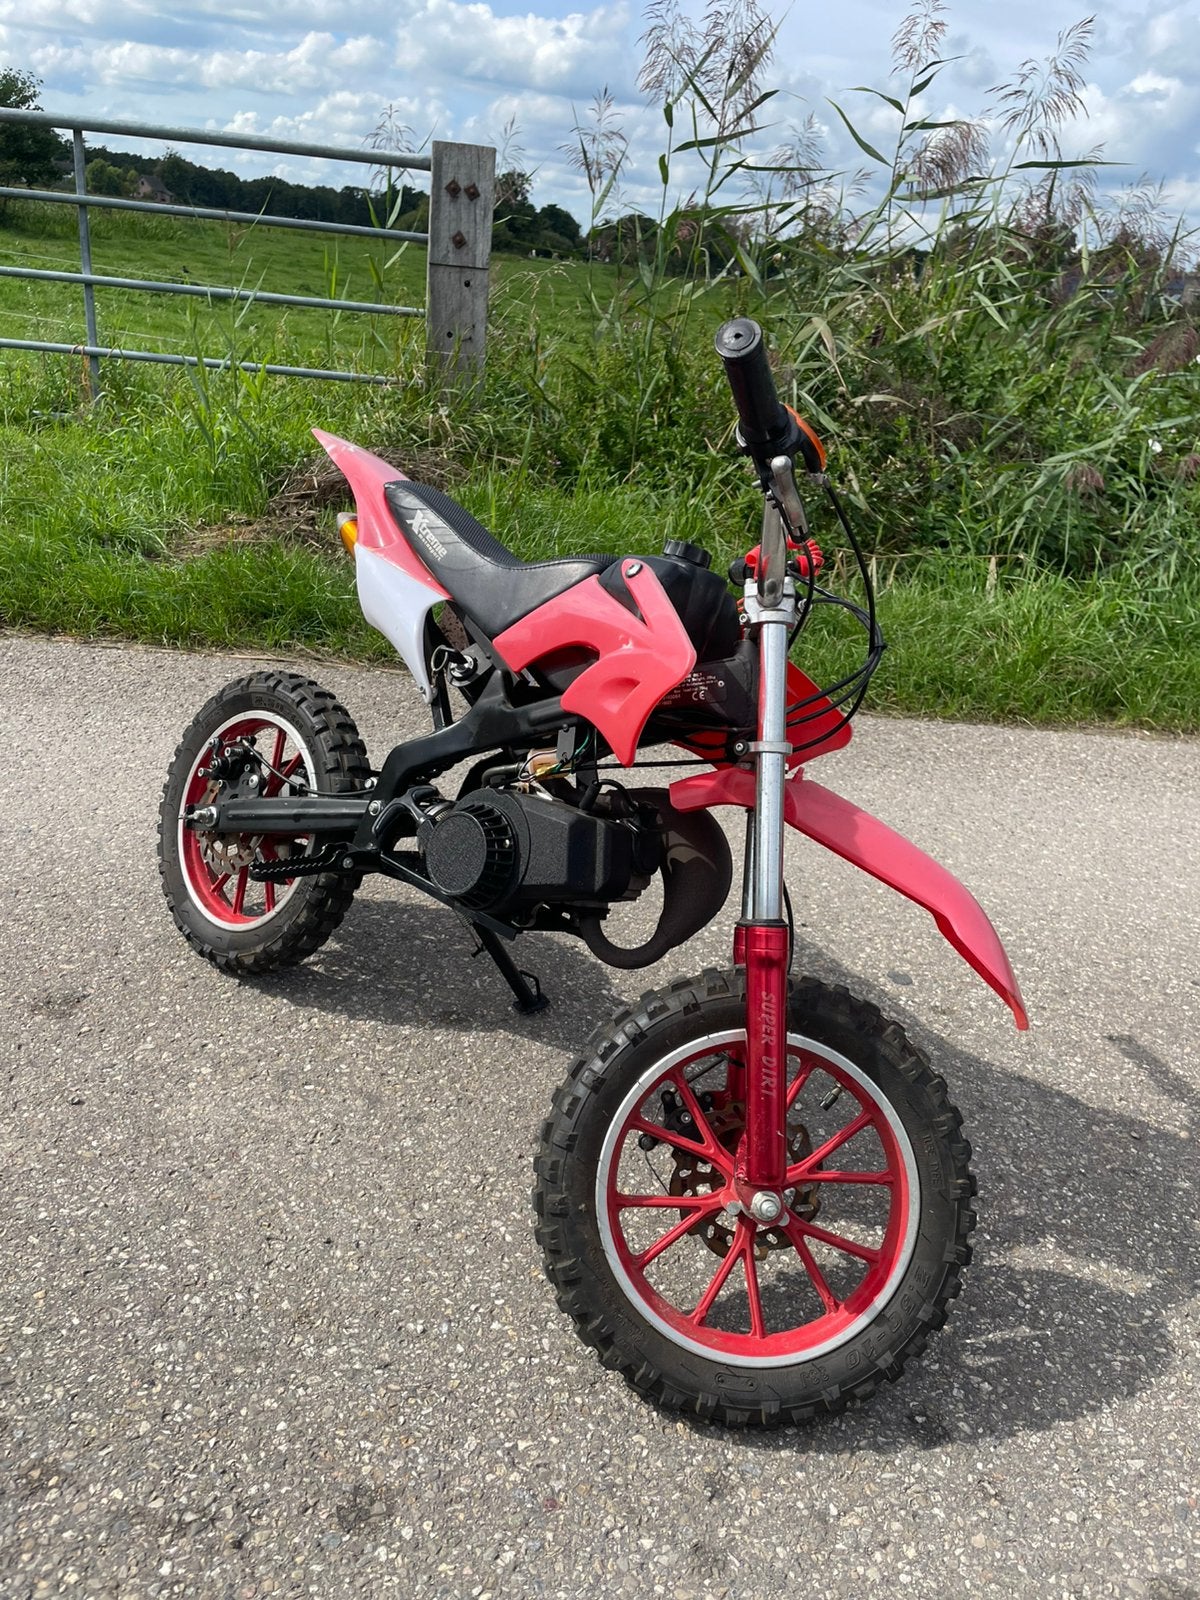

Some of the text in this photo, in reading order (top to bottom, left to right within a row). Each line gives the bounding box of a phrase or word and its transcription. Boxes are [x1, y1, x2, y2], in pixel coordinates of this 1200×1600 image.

[405, 509, 448, 558] Xtreme
[692, 691, 705, 701] CE
[761, 991, 777, 1097] SUPER DIRT
